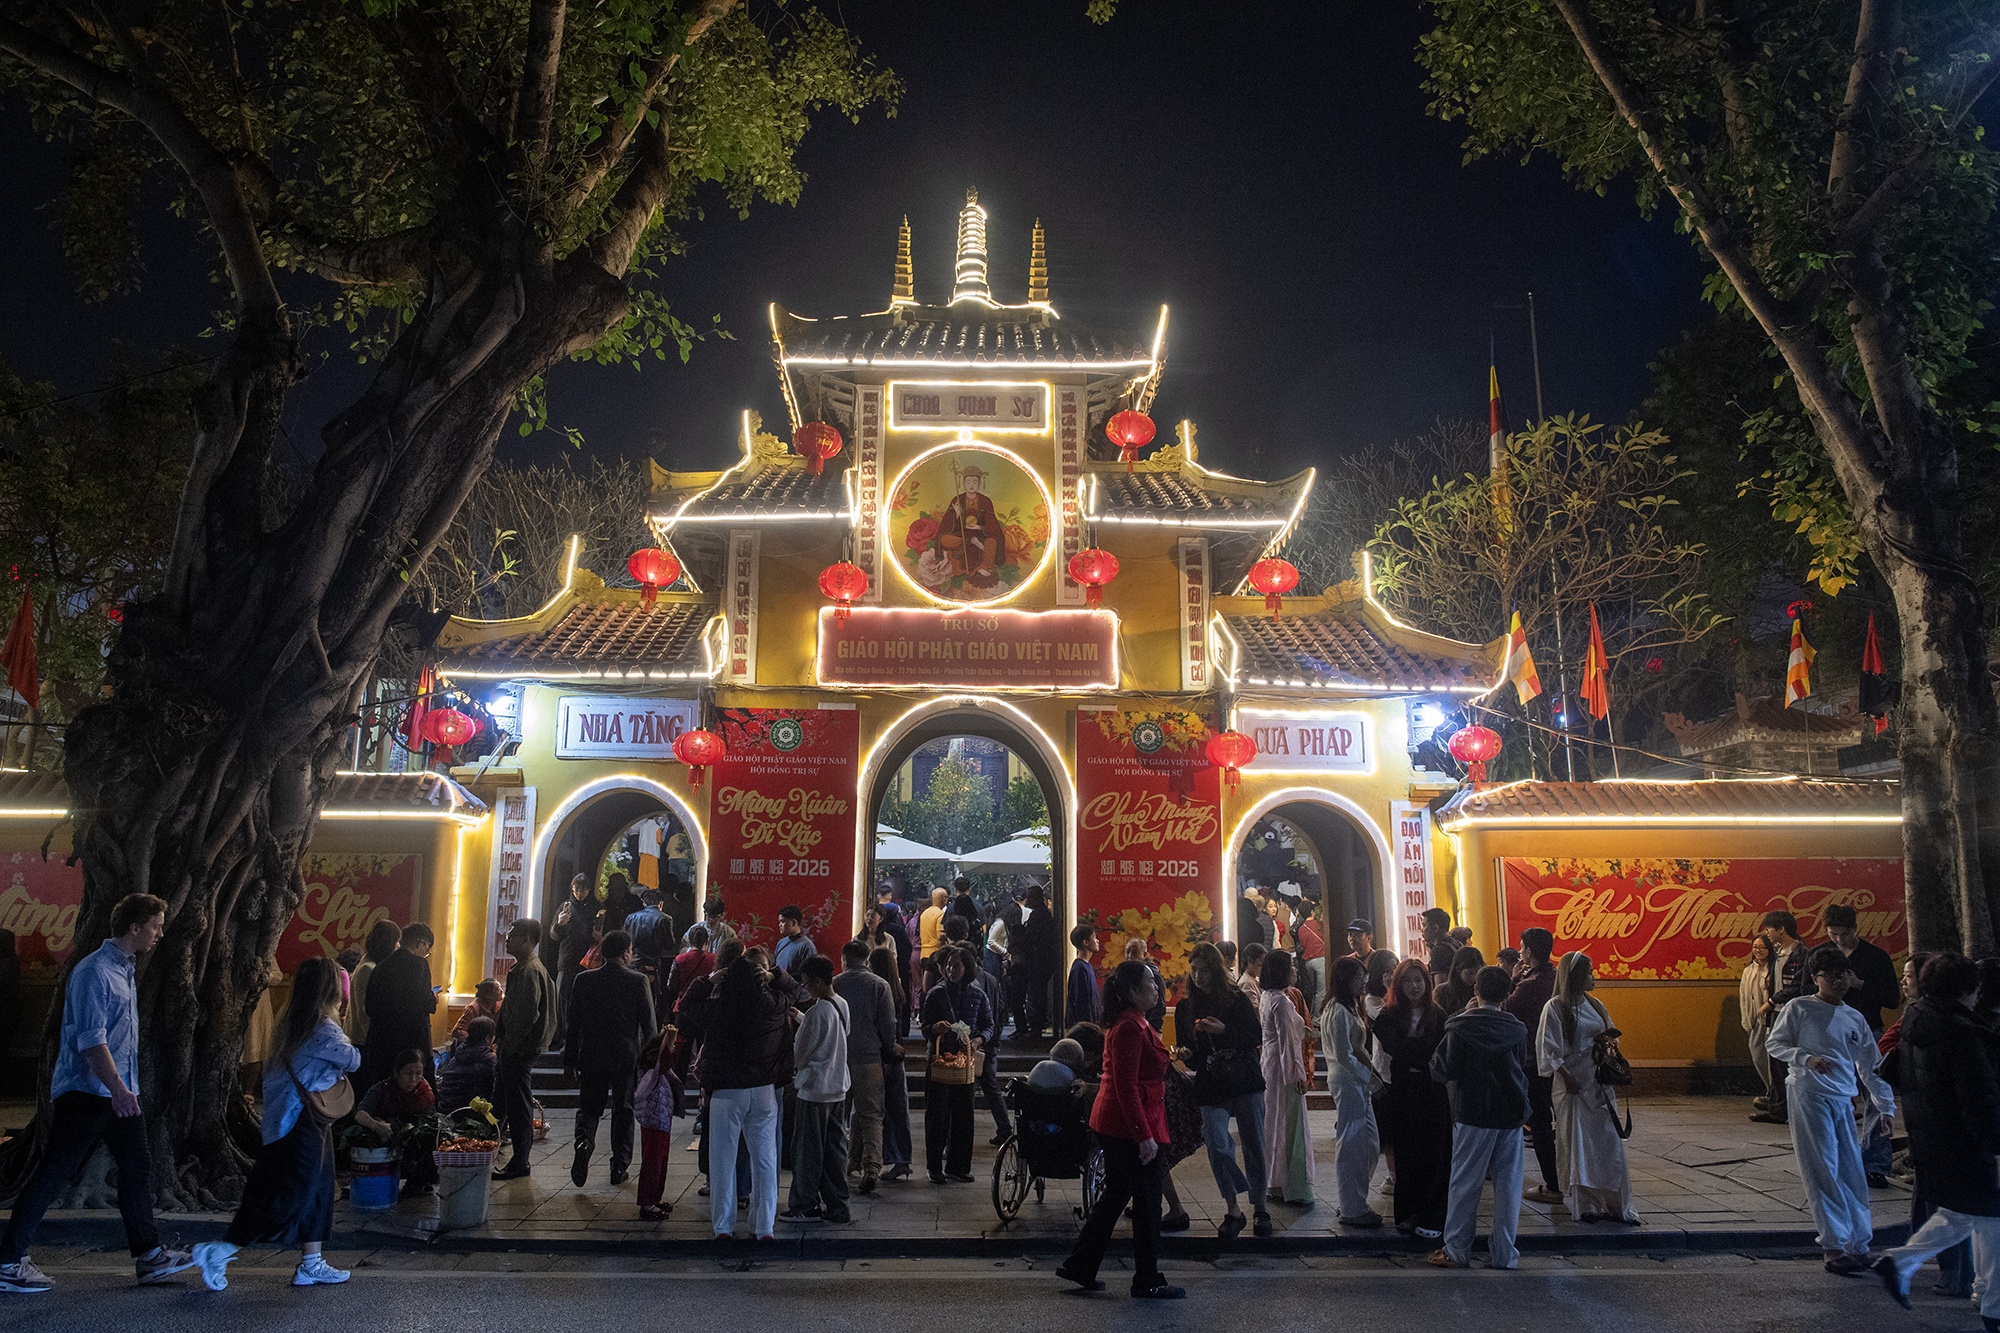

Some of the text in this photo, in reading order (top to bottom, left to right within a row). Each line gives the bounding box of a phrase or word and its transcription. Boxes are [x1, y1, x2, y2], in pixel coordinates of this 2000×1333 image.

[940, 615, 999, 634] TRỤ SỞ
[837, 635, 1099, 664] GIÁO HỘI PHẬT GIÁO VIỆT NAM
[578, 710, 685, 744] NHÀ TĂNG
[1297, 726, 1353, 757] PHÁP
[723, 754, 744, 763] GIÁO
[745, 753, 763, 764] HỘI
[763, 753, 784, 765] PHẬT
[786, 755, 807, 764] GIÁO
[808, 755, 828, 766] VIỆT
[1087, 756, 1108, 764] GIÁO
[1109, 756, 1125, 766] HỘI
[1126, 756, 1147, 766] PHẬT
[1149, 757, 1170, 765] GIÁO
[1170, 757, 1190, 766] VIỆT
[750, 766, 765, 775] HỘI
[792, 767, 807, 776] TRỊ
[808, 767, 820, 776] SỰ
[1114, 767, 1130, 777] HỘI
[1156, 769, 1170, 777] TRỊ
[718, 786, 848, 821] Mừng Xuân
[1081, 790, 1152, 830] Chúc
[777, 819, 822, 857] Lặc
[1401, 821, 1421, 839] ĐẠO
[788, 859, 830, 876] 2026
[1158, 860, 1199, 877] 2026
[1530, 887, 1645, 945] Chúc
